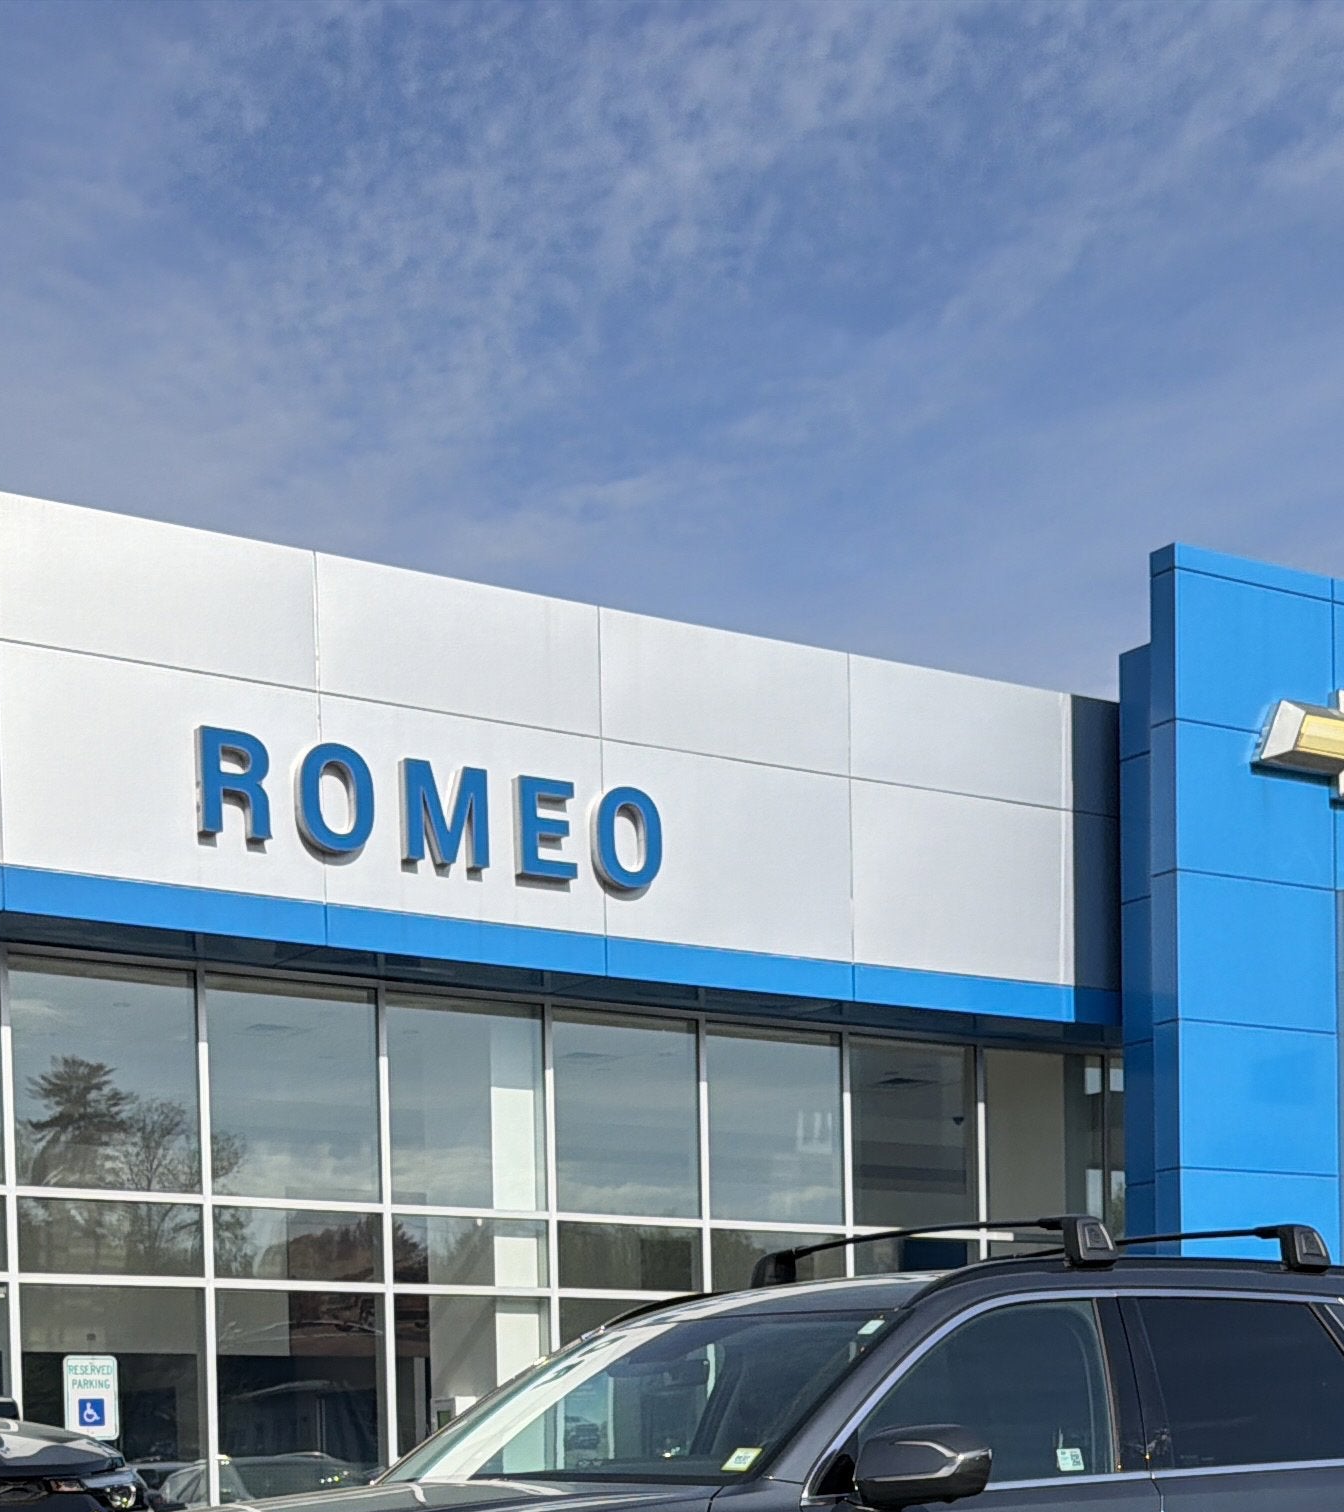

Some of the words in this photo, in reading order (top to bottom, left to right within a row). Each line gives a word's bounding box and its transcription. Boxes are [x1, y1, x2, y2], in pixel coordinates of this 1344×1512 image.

[194, 725, 663, 890] ROMEO
[68, 1364, 113, 1376] RESERVED
[72, 1379, 111, 1390] PARKING
